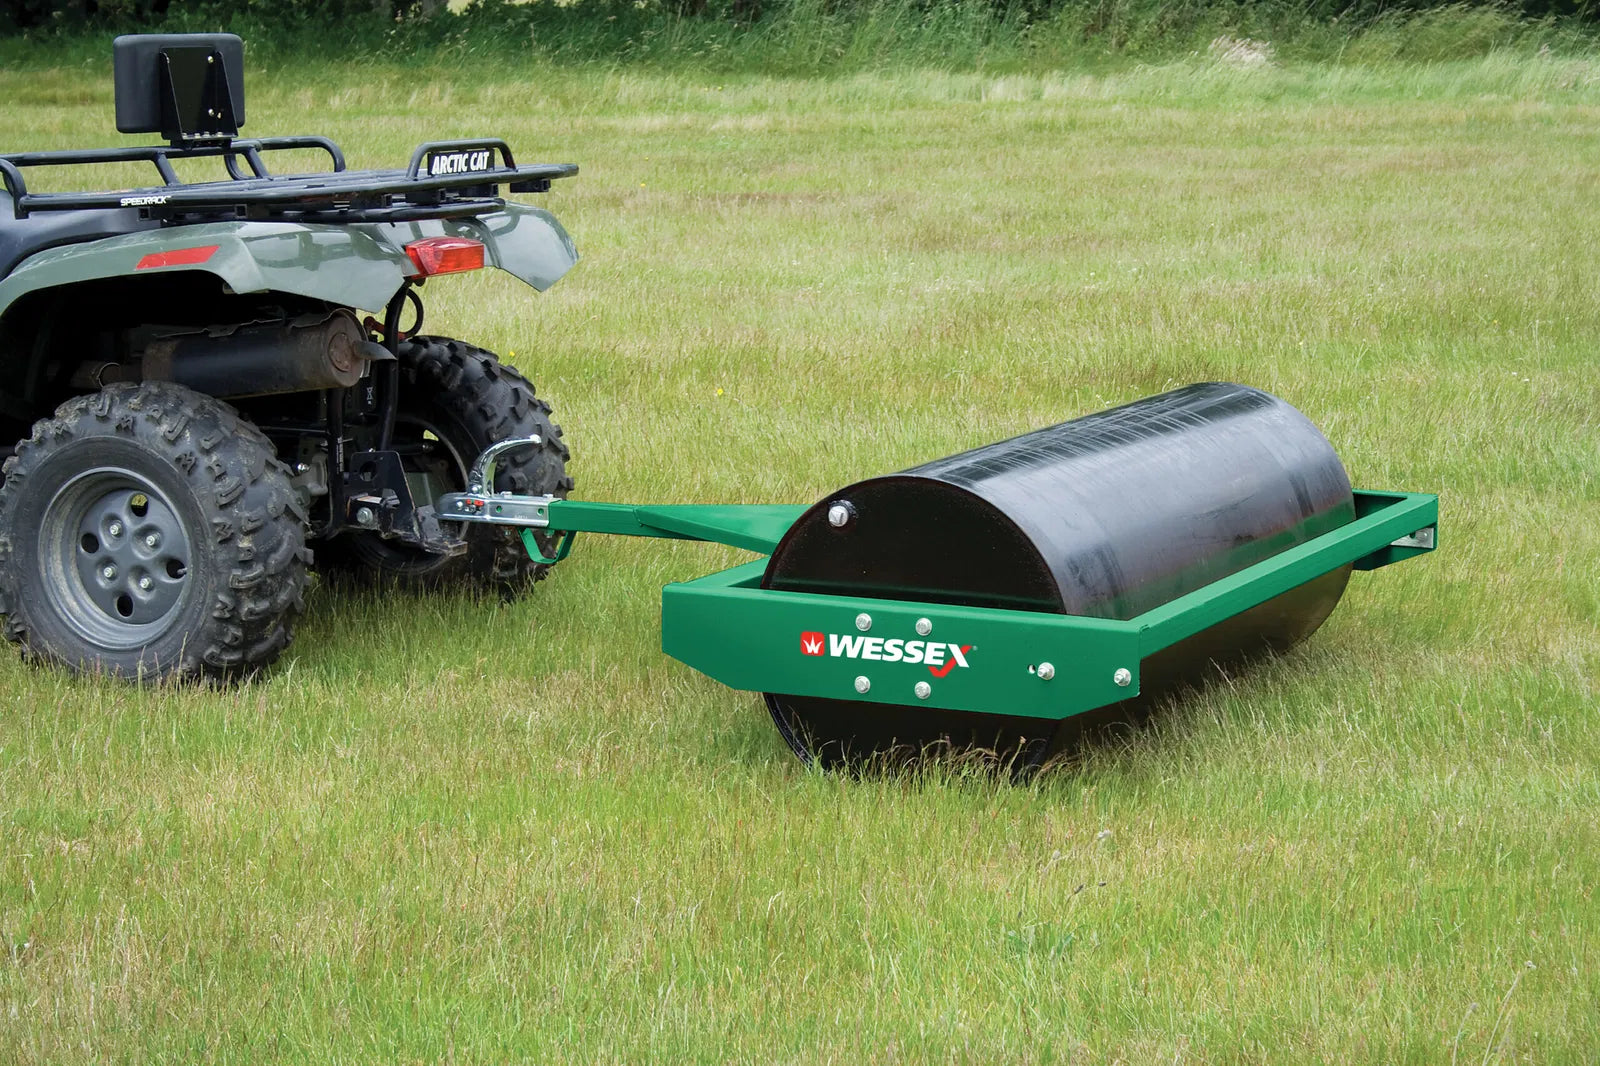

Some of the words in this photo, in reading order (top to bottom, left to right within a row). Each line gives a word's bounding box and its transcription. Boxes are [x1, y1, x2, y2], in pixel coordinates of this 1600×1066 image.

[431, 153, 469, 175] ARCTIC
[470, 151, 490, 171] CAT
[828, 633, 973, 678] WESSEX
